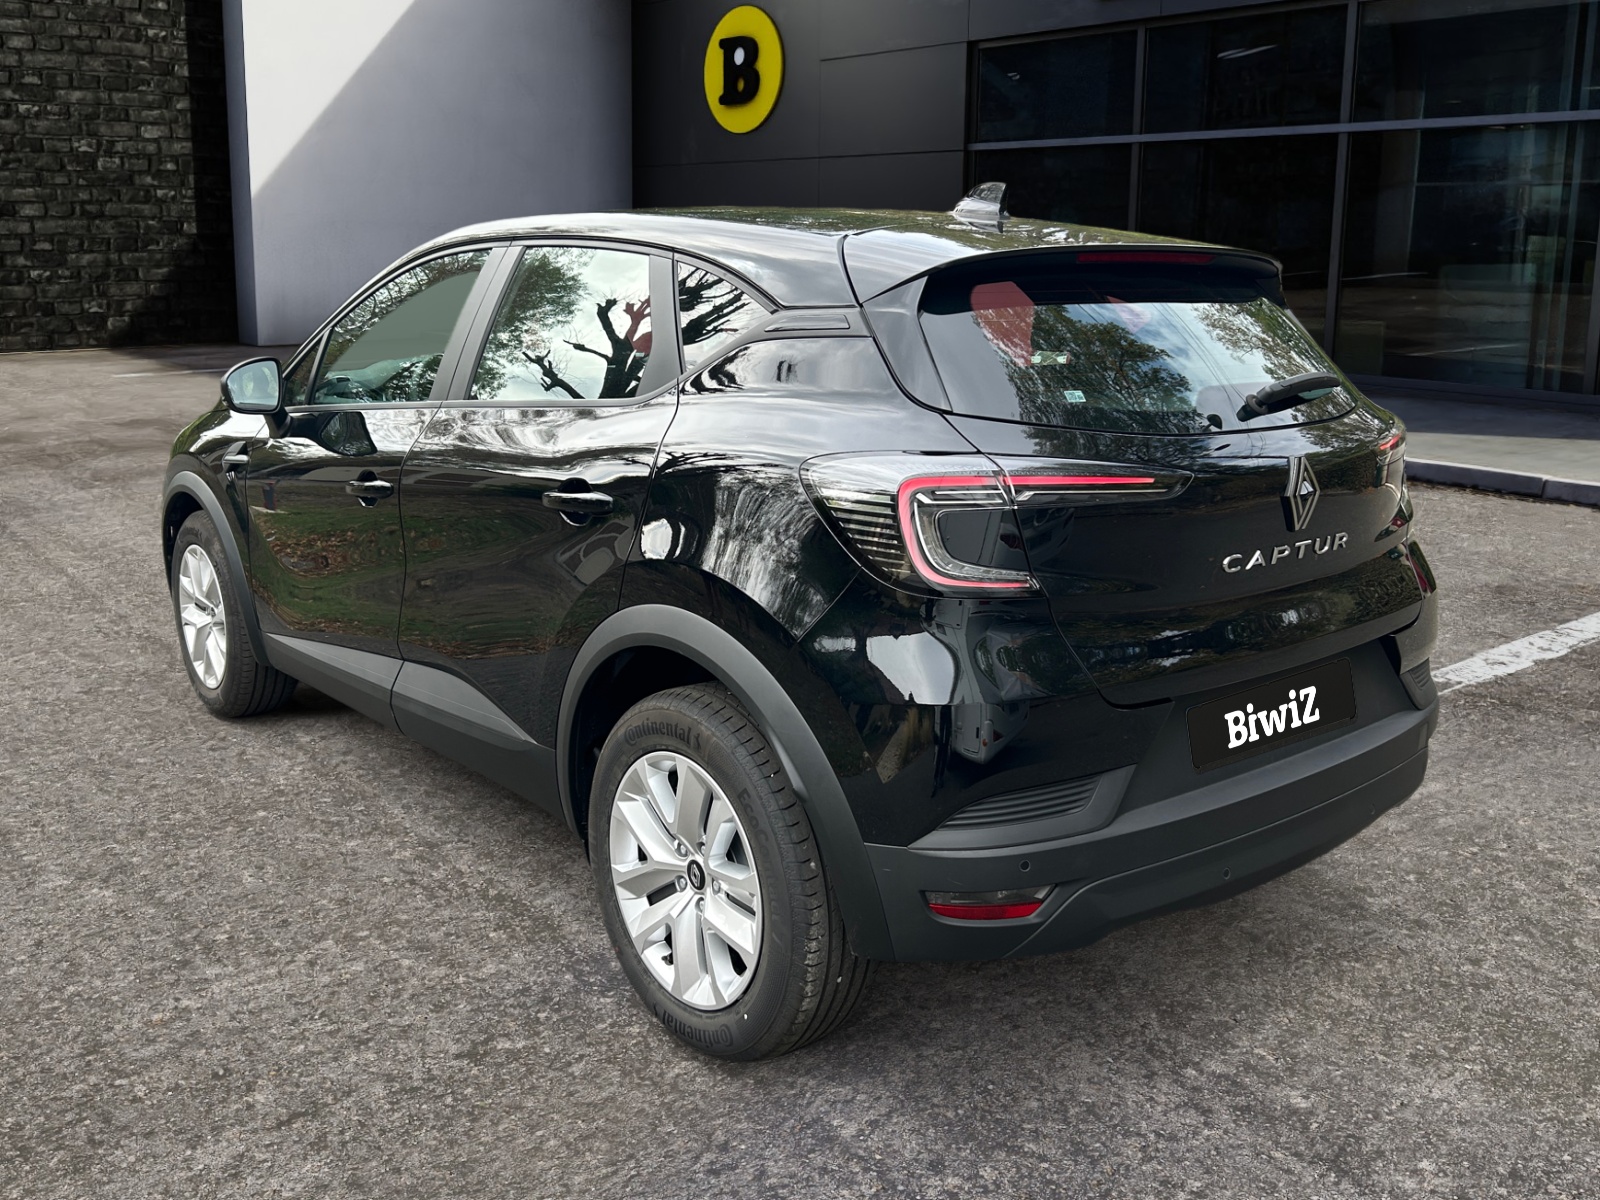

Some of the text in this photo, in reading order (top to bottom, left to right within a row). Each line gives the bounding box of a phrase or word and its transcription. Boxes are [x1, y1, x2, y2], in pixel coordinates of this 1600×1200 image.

[718, 35, 760, 106] B
[1222, 532, 1348, 573] CAPTUR
[624, 717, 692, 747] Continental
[662, 1009, 733, 1048] Continental
